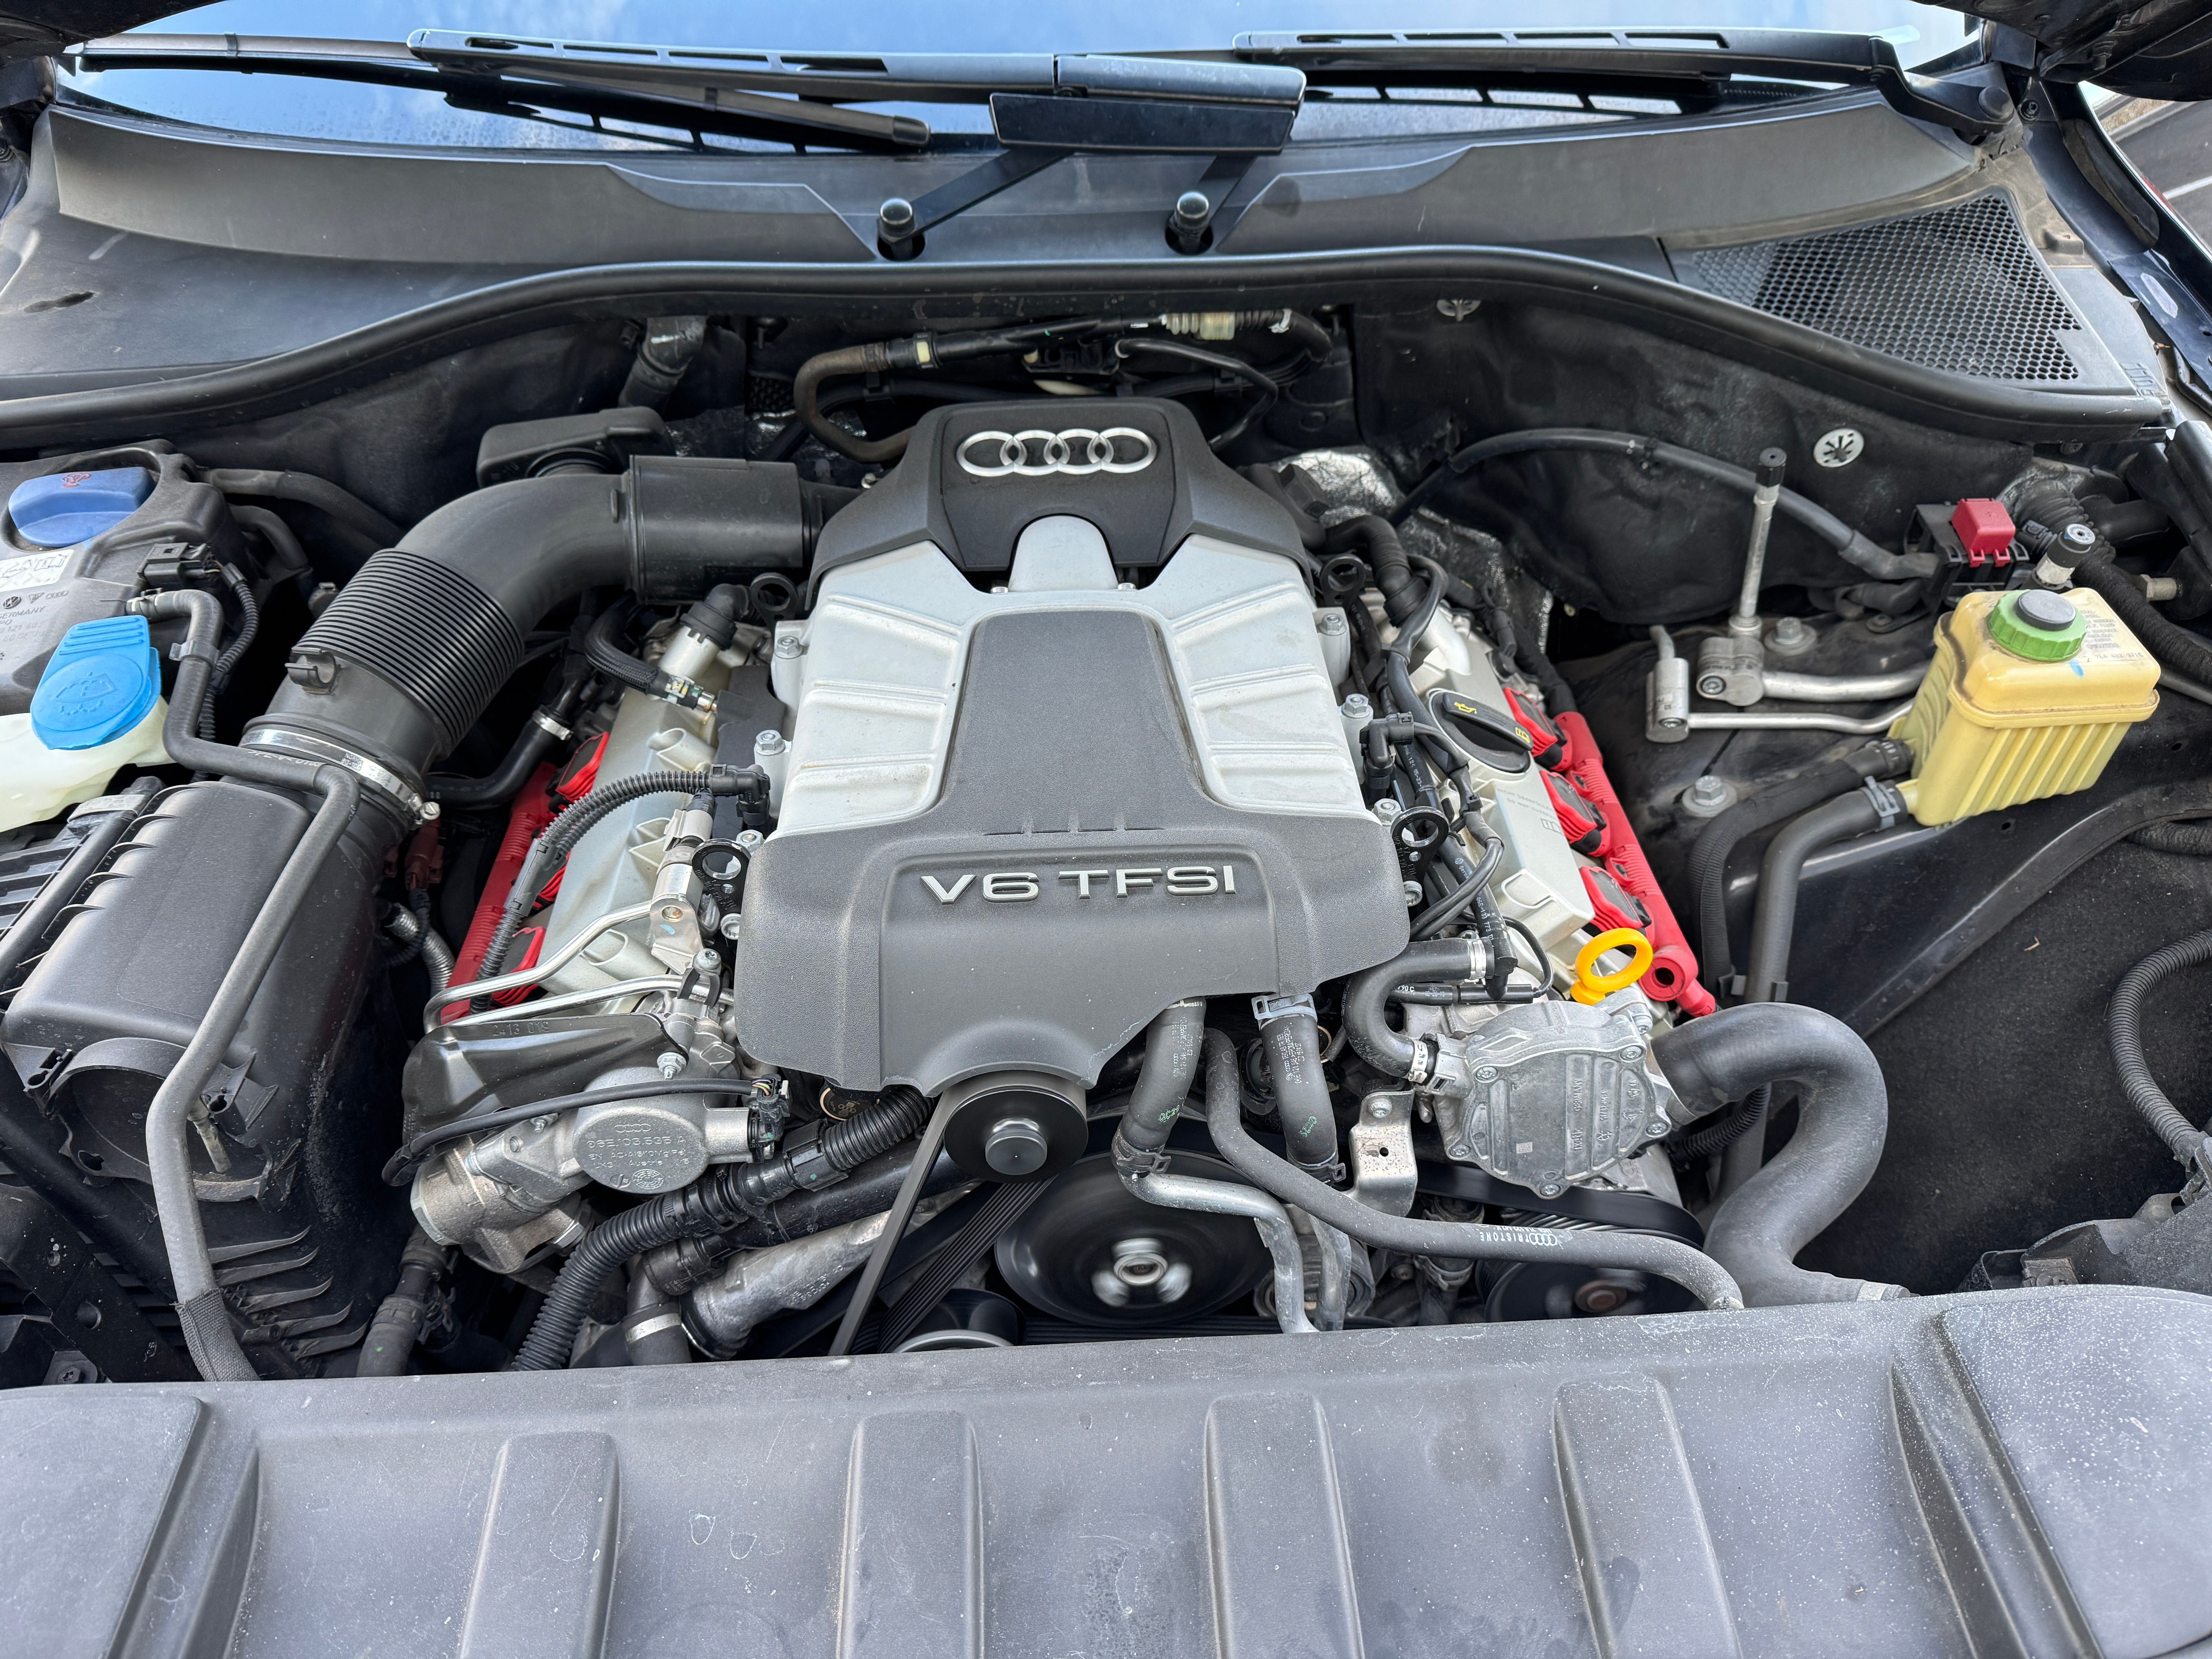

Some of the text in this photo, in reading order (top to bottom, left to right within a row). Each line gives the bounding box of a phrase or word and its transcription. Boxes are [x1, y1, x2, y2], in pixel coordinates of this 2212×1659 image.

[920, 866, 1237, 905] V6 TFSI
[1573, 1079, 1583, 1111] GERMANY
[678, 1135, 687, 1144] A
[1479, 1231, 1530, 1243] TRISTONE
